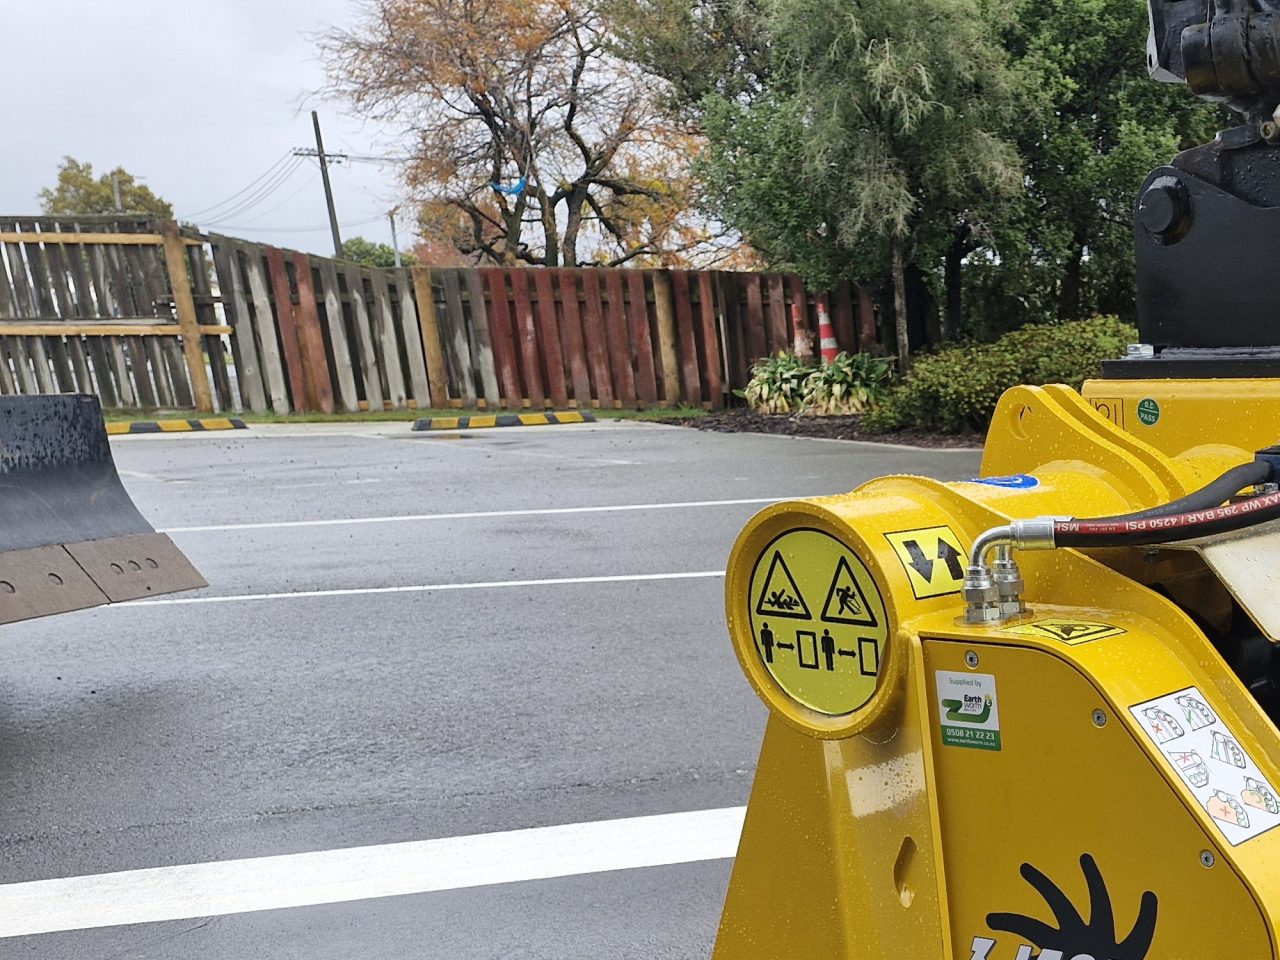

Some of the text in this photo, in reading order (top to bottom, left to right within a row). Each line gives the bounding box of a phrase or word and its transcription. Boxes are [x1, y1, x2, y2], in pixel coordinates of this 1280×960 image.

[1140, 413, 1156, 422] PASS
[1218, 505, 1239, 517] 295
[1241, 500, 1262, 513] WP
[1149, 517, 1178, 529] 4250
[1187, 511, 1215, 524] BAR
[1125, 521, 1147, 530] PSI
[948, 678, 982, 688] Supplied by
[963, 694, 982, 703] Earth
[963, 702, 982, 710] worm
[946, 728, 995, 740] 0508 21 22 23
